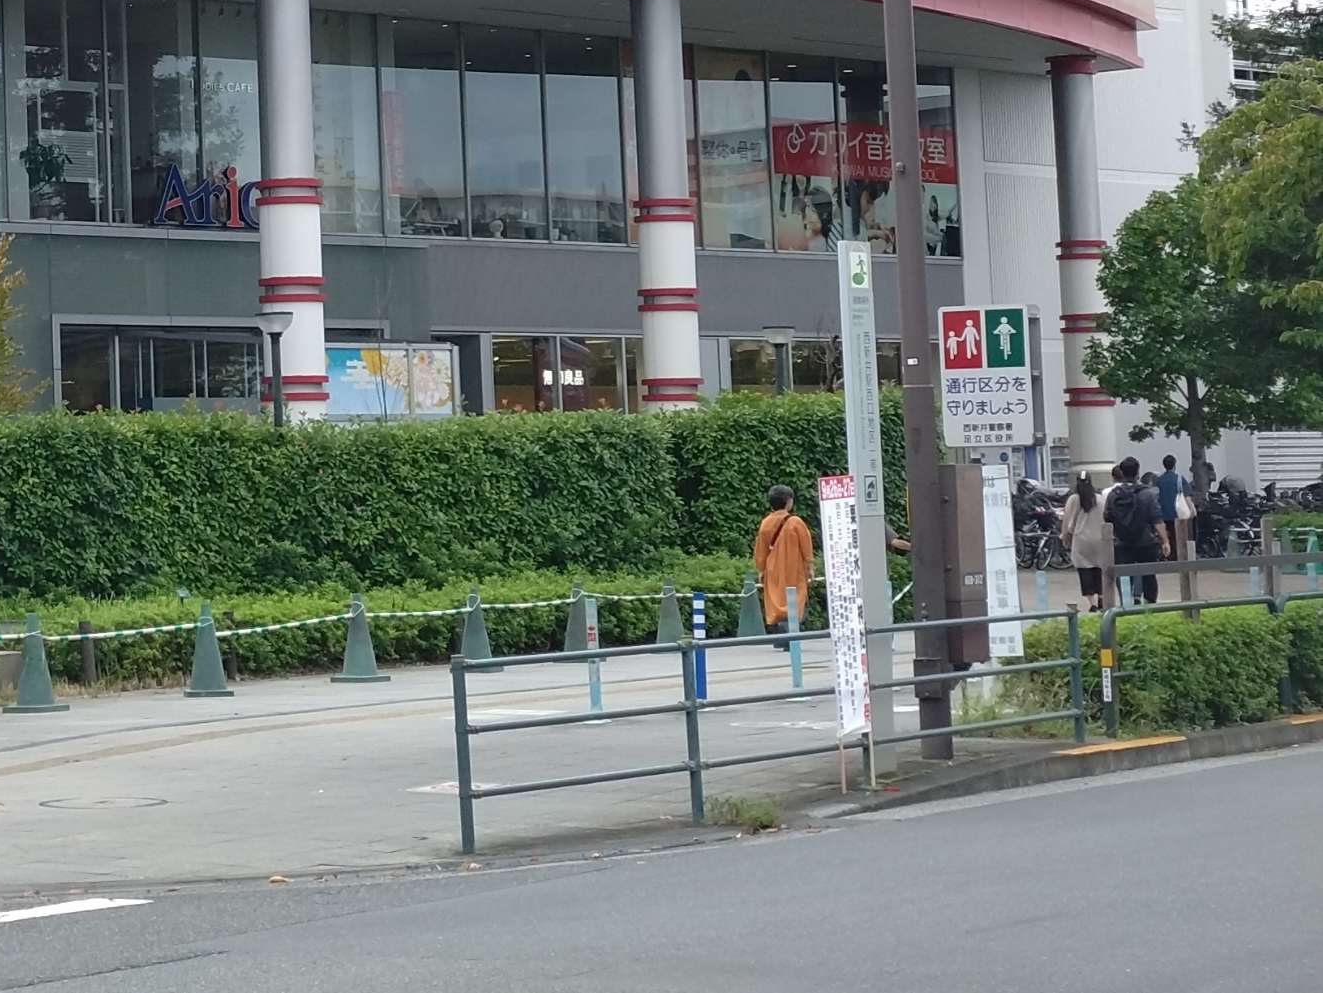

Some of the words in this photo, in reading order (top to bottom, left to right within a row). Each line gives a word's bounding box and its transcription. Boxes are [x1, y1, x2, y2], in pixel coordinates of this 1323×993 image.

[946, 376, 1026, 394] 通行区分を
[946, 398, 1028, 416] 守りましょう
